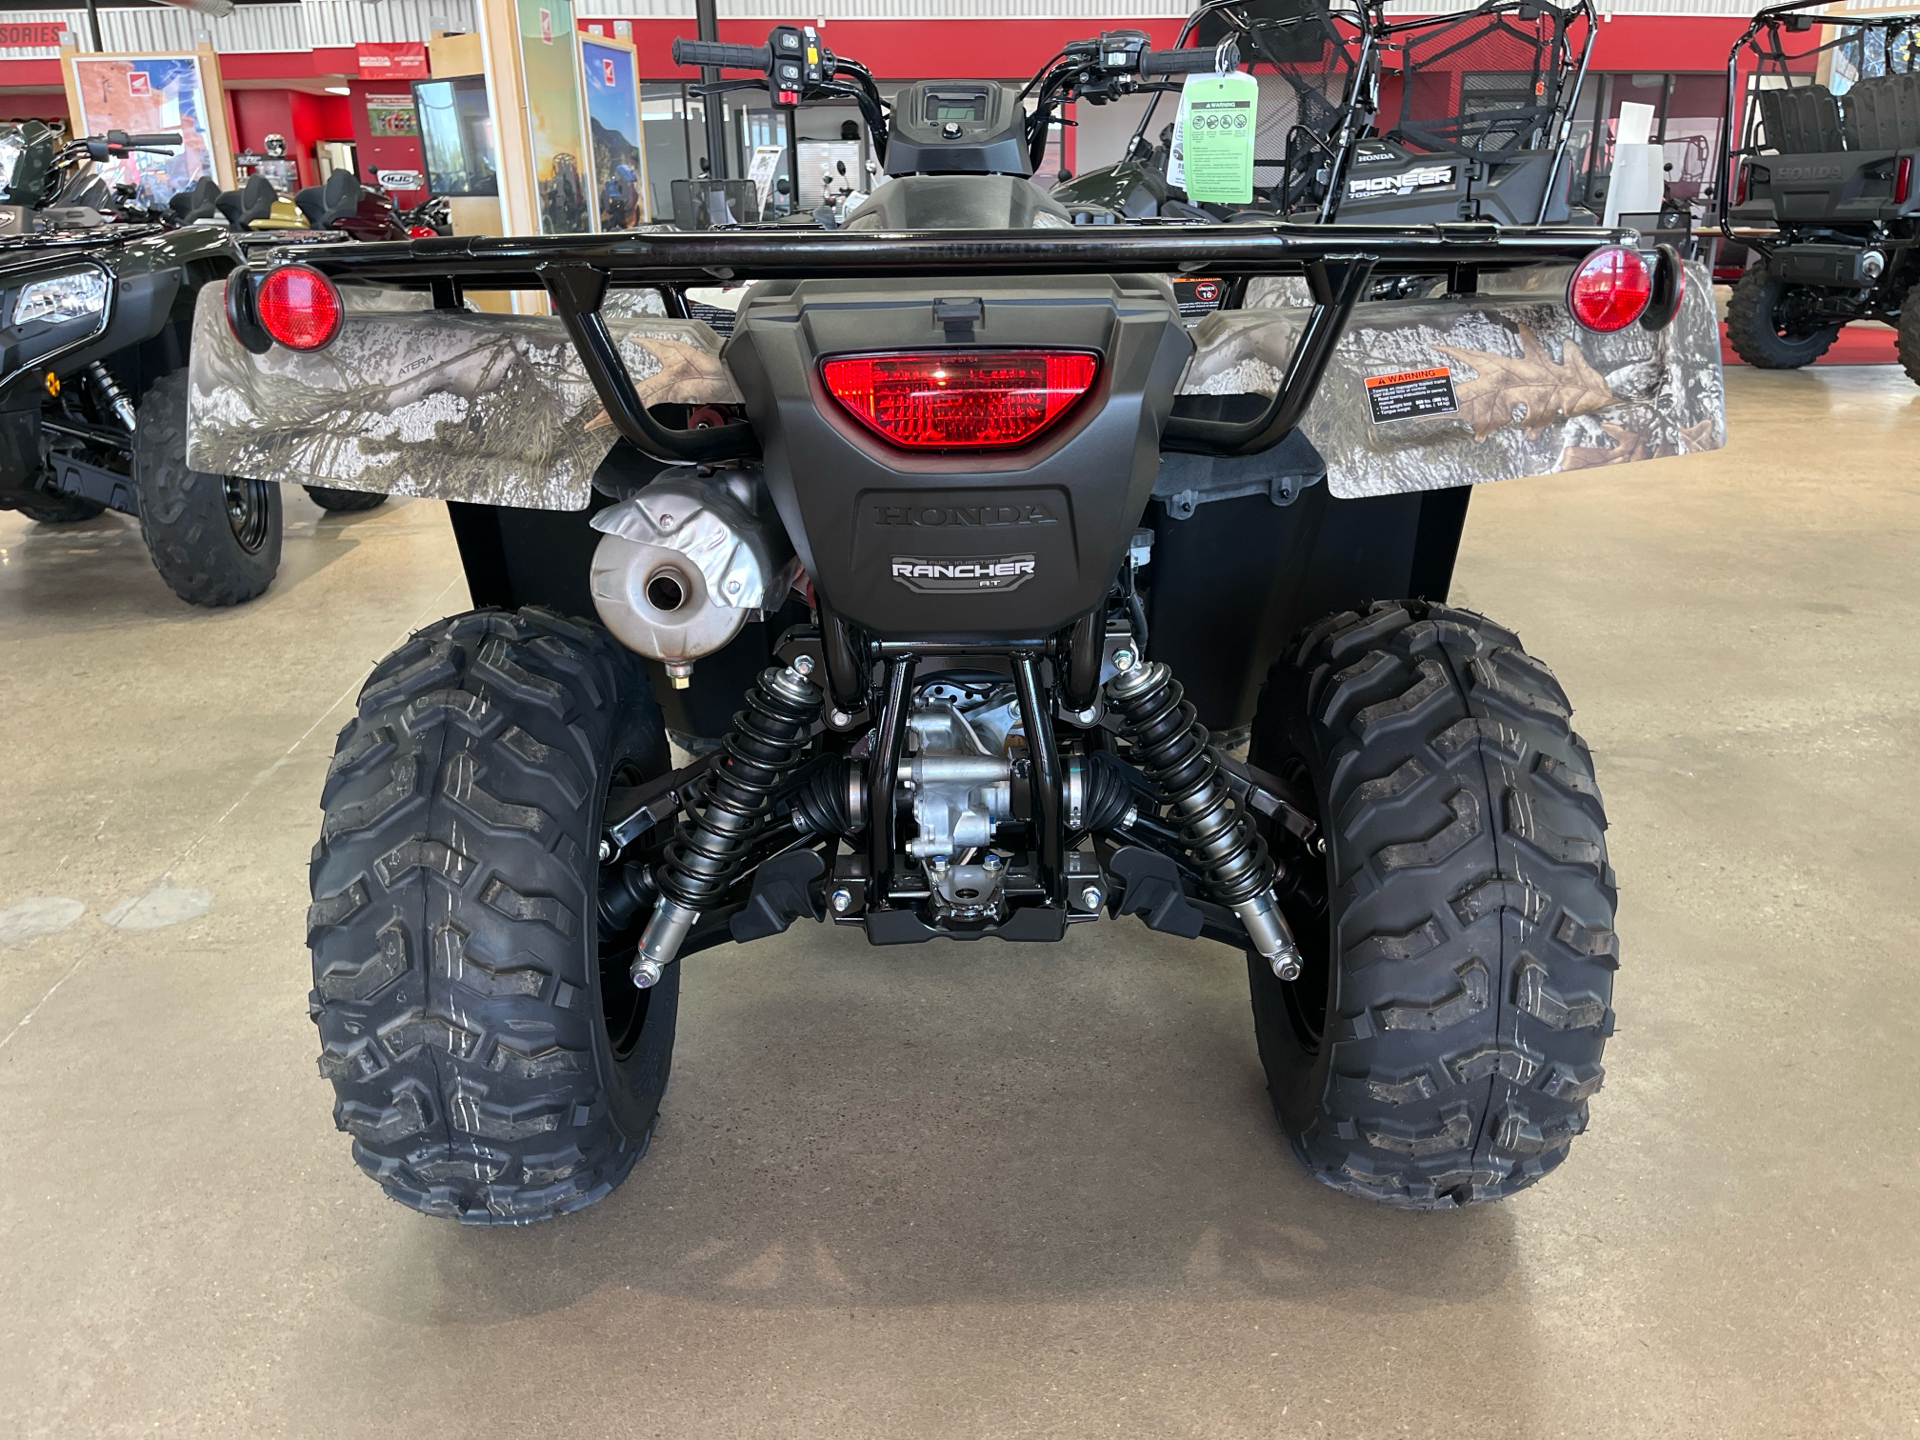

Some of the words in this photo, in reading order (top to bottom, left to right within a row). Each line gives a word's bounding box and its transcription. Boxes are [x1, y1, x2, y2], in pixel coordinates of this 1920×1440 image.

[0, 26, 60, 43] SORIES
[1358, 152, 1395, 162] HONDA
[1350, 170, 1452, 192] PIONEER
[1388, 370, 1436, 383] WARNING
[874, 504, 1058, 527] HONDA
[892, 561, 1035, 578] RANCHER
